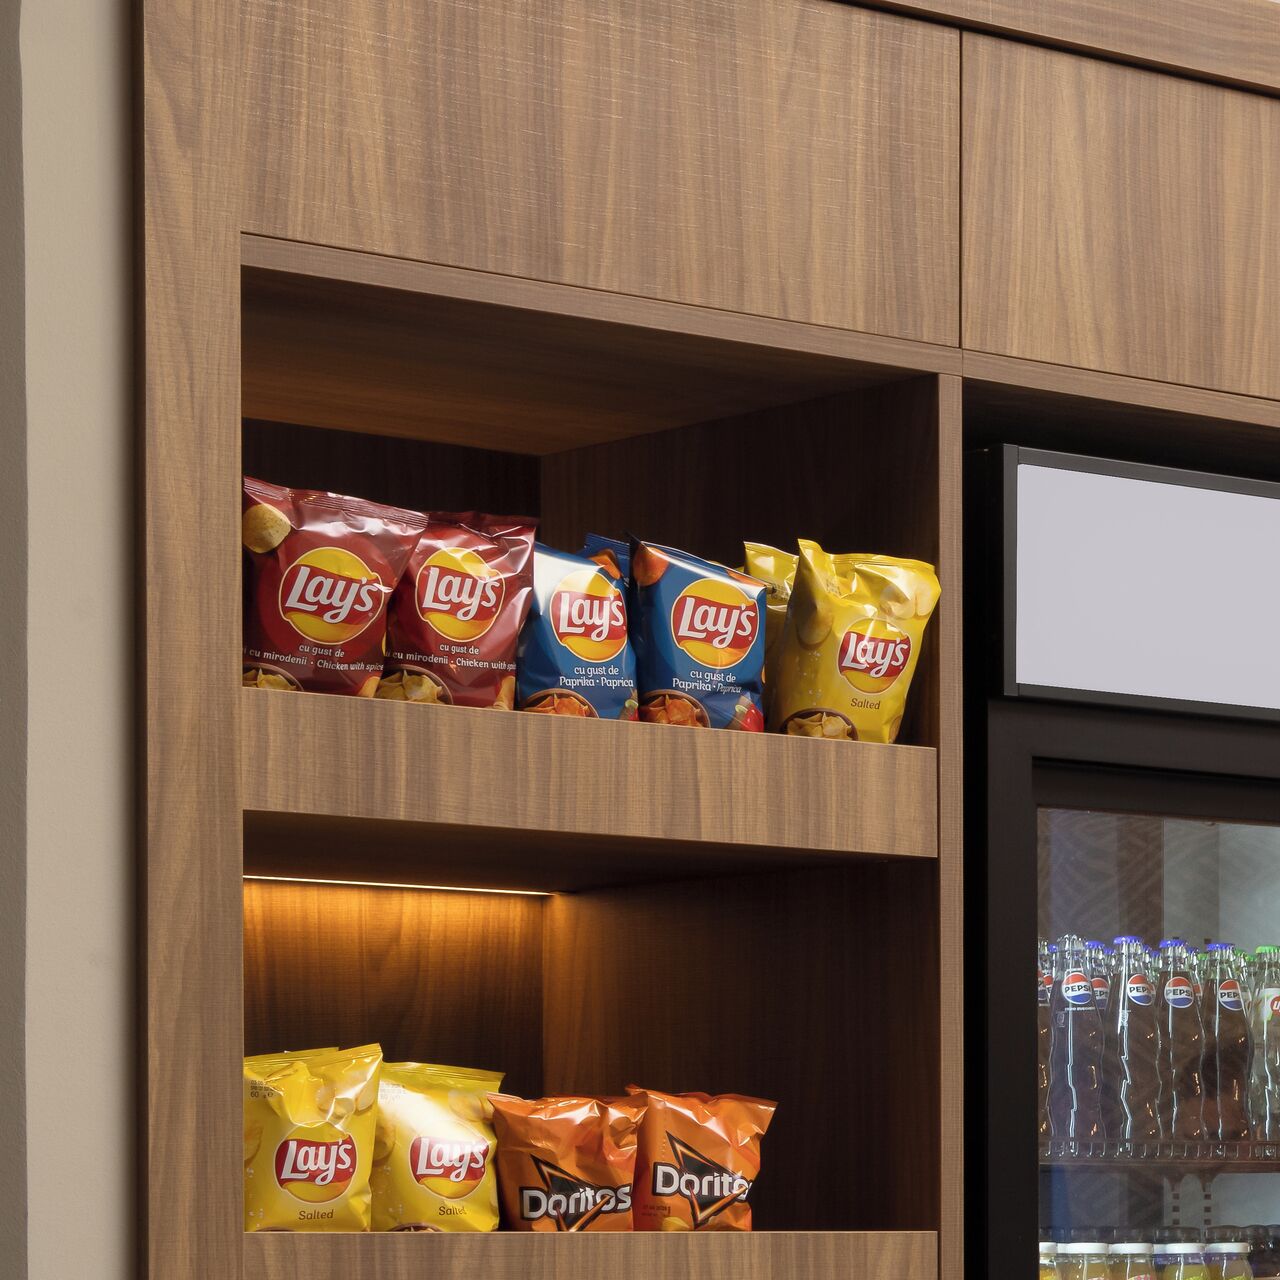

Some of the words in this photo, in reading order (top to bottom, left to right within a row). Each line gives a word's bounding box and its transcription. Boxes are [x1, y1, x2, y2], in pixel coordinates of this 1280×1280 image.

[286, 566, 380, 624] Lay's
[422, 566, 500, 622] Lay's
[559, 591, 626, 642] Lay's
[677, 596, 757, 649] Lay's
[298, 643, 310, 653] cu
[311, 645, 333, 657] gust
[334, 648, 345, 658] de
[439, 643, 450, 652] cu
[450, 644, 468, 654] gust
[468, 645, 480, 655] de
[841, 632, 908, 678] Lay's
[262, 651, 308, 665] mirodenii
[316, 659, 349, 671] Chicken
[349, 663, 365, 671] with
[405, 652, 449, 665] mirodenii
[455, 657, 489, 669] Chicken
[573, 666, 585, 676] cu
[586, 665, 606, 677] gust
[607, 664, 620, 676] de
[689, 669, 703, 679] cu
[704, 671, 725, 683] gust
[725, 672, 737, 684] de
[559, 676, 596, 690] Paprika
[600, 676, 635, 690] Paprica
[672, 677, 712, 692] Paprika
[849, 697, 882, 711] Salted
[281, 1138, 353, 1187] Lay's
[416, 1136, 485, 1183] Lay's
[521, 1186, 633, 1221] Doritos
[297, 1208, 335, 1221] Salted
